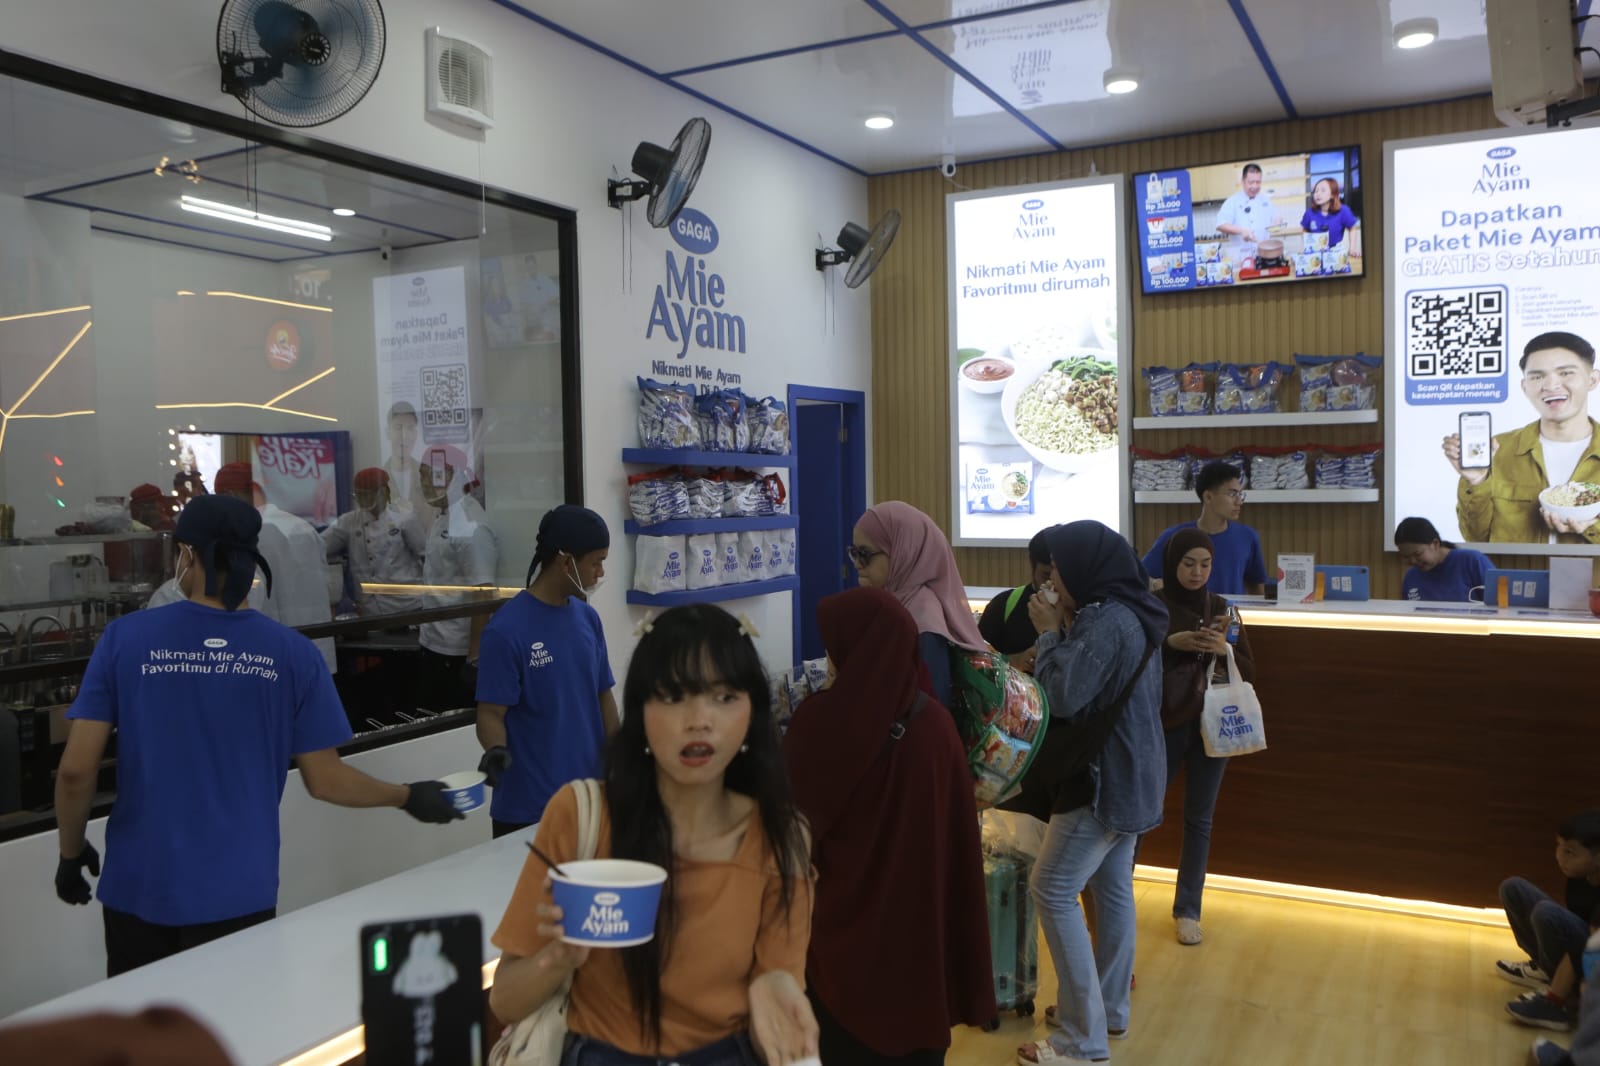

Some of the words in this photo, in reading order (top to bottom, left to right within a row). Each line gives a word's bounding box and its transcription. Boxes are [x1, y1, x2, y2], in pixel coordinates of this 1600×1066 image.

[1482, 163, 1520, 178] Mie
[1472, 178, 1530, 196] Ayam
[1019, 213, 1048, 226] Mie
[1441, 204, 1562, 230] Dapatkan
[677, 218, 711, 242] GAGA
[1013, 226, 1055, 242] Ayam
[1405, 233, 1471, 254] Paket
[1479, 229, 1523, 248] Mie
[1530, 226, 1600, 247] Ayam
[966, 261, 1026, 280] Nikmati
[1030, 260, 1058, 274] Mie
[1062, 257, 1105, 273] Ayam
[1402, 251, 1490, 278] GRATIS
[666, 250, 725, 308] Mie
[962, 281, 1037, 298] Favoritmu
[1042, 274, 1110, 292] dirumah
[646, 285, 746, 359] Ayam
[652, 360, 691, 378] Nikmati
[696, 365, 712, 380] Mie
[717, 368, 741, 385] Ayam
[1412, 391, 1464, 400] kesempatan
[1465, 390, 1500, 399] menang
[1417, 384, 1438, 392] Scan
[1440, 383, 1452, 392] QR
[1454, 382, 1495, 392] dapatkan
[666, 560, 680, 570] Mie
[150, 650, 205, 661] Nikmati
[209, 651, 234, 661] Mie
[238, 652, 274, 666] Ayam
[529, 655, 553, 668] Ayam
[531, 650, 548, 660] Mie
[141, 662, 211, 675] Favoritmu
[215, 662, 229, 673] di
[232, 663, 279, 682] Rumah
[1221, 715, 1245, 728] Mie
[1219, 724, 1253, 740] Ayam
[590, 904, 623, 921] Mie
[581, 917, 629, 937] Ayam
